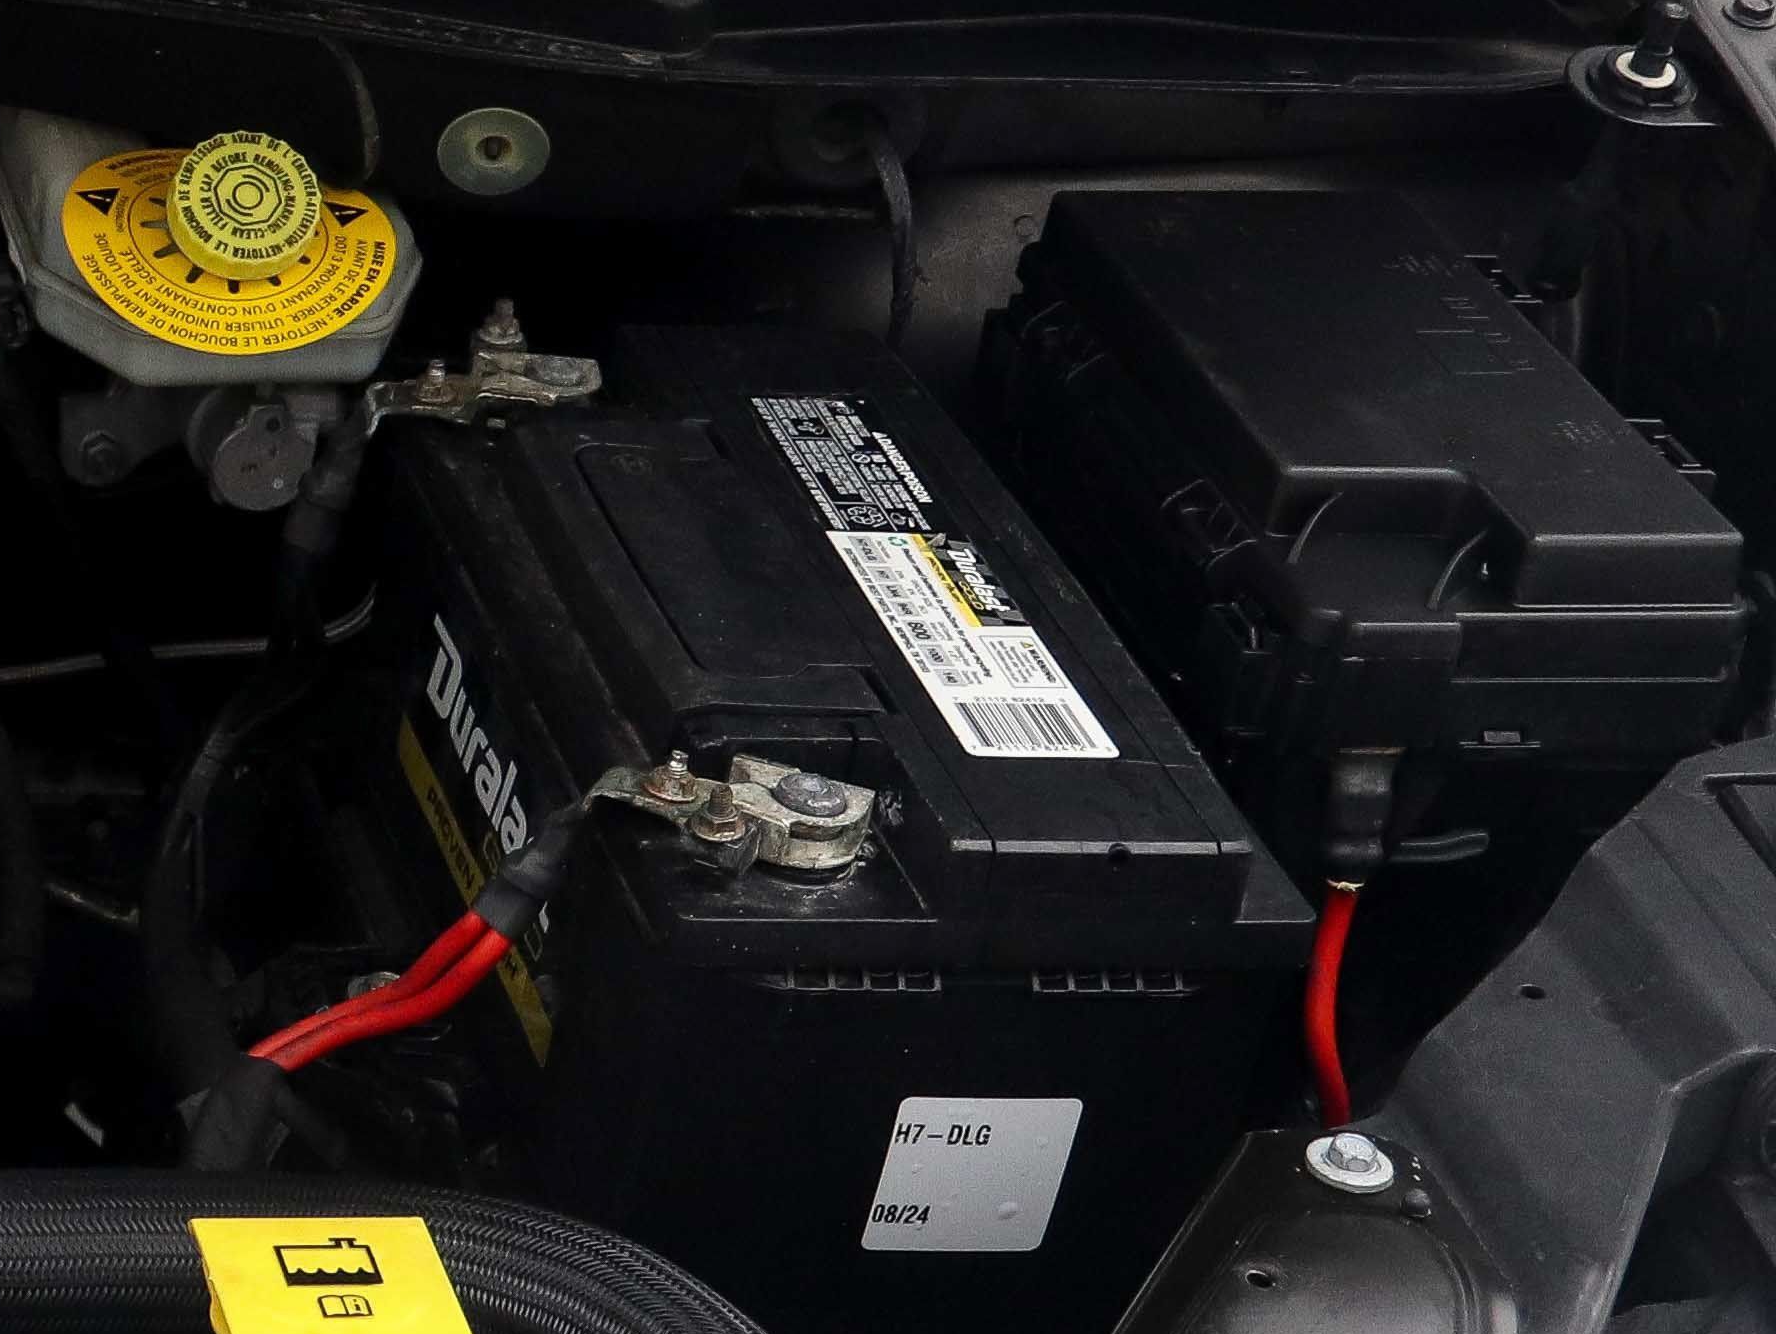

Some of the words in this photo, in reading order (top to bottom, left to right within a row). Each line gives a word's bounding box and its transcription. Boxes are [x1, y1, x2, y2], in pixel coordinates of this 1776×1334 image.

[232, 133, 263, 145] AVANT
[267, 139, 279, 152] DE
[180, 136, 227, 185] REMPLISSAGE
[210, 152, 248, 173] BEFORE
[200, 173, 215, 192] CAP
[178, 190, 190, 201] DE
[201, 196, 229, 231] FILLER
[181, 206, 214, 243] BOUCHON
[93, 232, 122, 273] LIQUIDE
[214, 240, 229, 254] LE
[335, 235, 347, 254] DOT
[352, 239, 368, 268] AVANT
[372, 241, 386, 267] MISE
[82, 253, 147, 318] REMPLISSAGE
[118, 273, 137, 289] DU
[344, 269, 359, 283] DE
[366, 269, 380, 282] EN
[281, 264, 340, 309] PROVENANT
[333, 282, 350, 294] LE
[134, 288, 220, 330] UNIQUEMENT
[156, 284, 237, 316] CONTENANT
[242, 305, 276, 315] D'UN
[333, 285, 371, 318] GARDE
[148, 315, 166, 329] DE
[225, 318, 285, 332] UTILISER
[263, 319, 328, 345] NETTOYER
[168, 324, 238, 347] BOUCHON
[244, 338, 258, 347] LE
[947, 548, 1010, 611] Duralast
[908, 622, 931, 640] 800
[872, 1204, 930, 1224] 08/24
